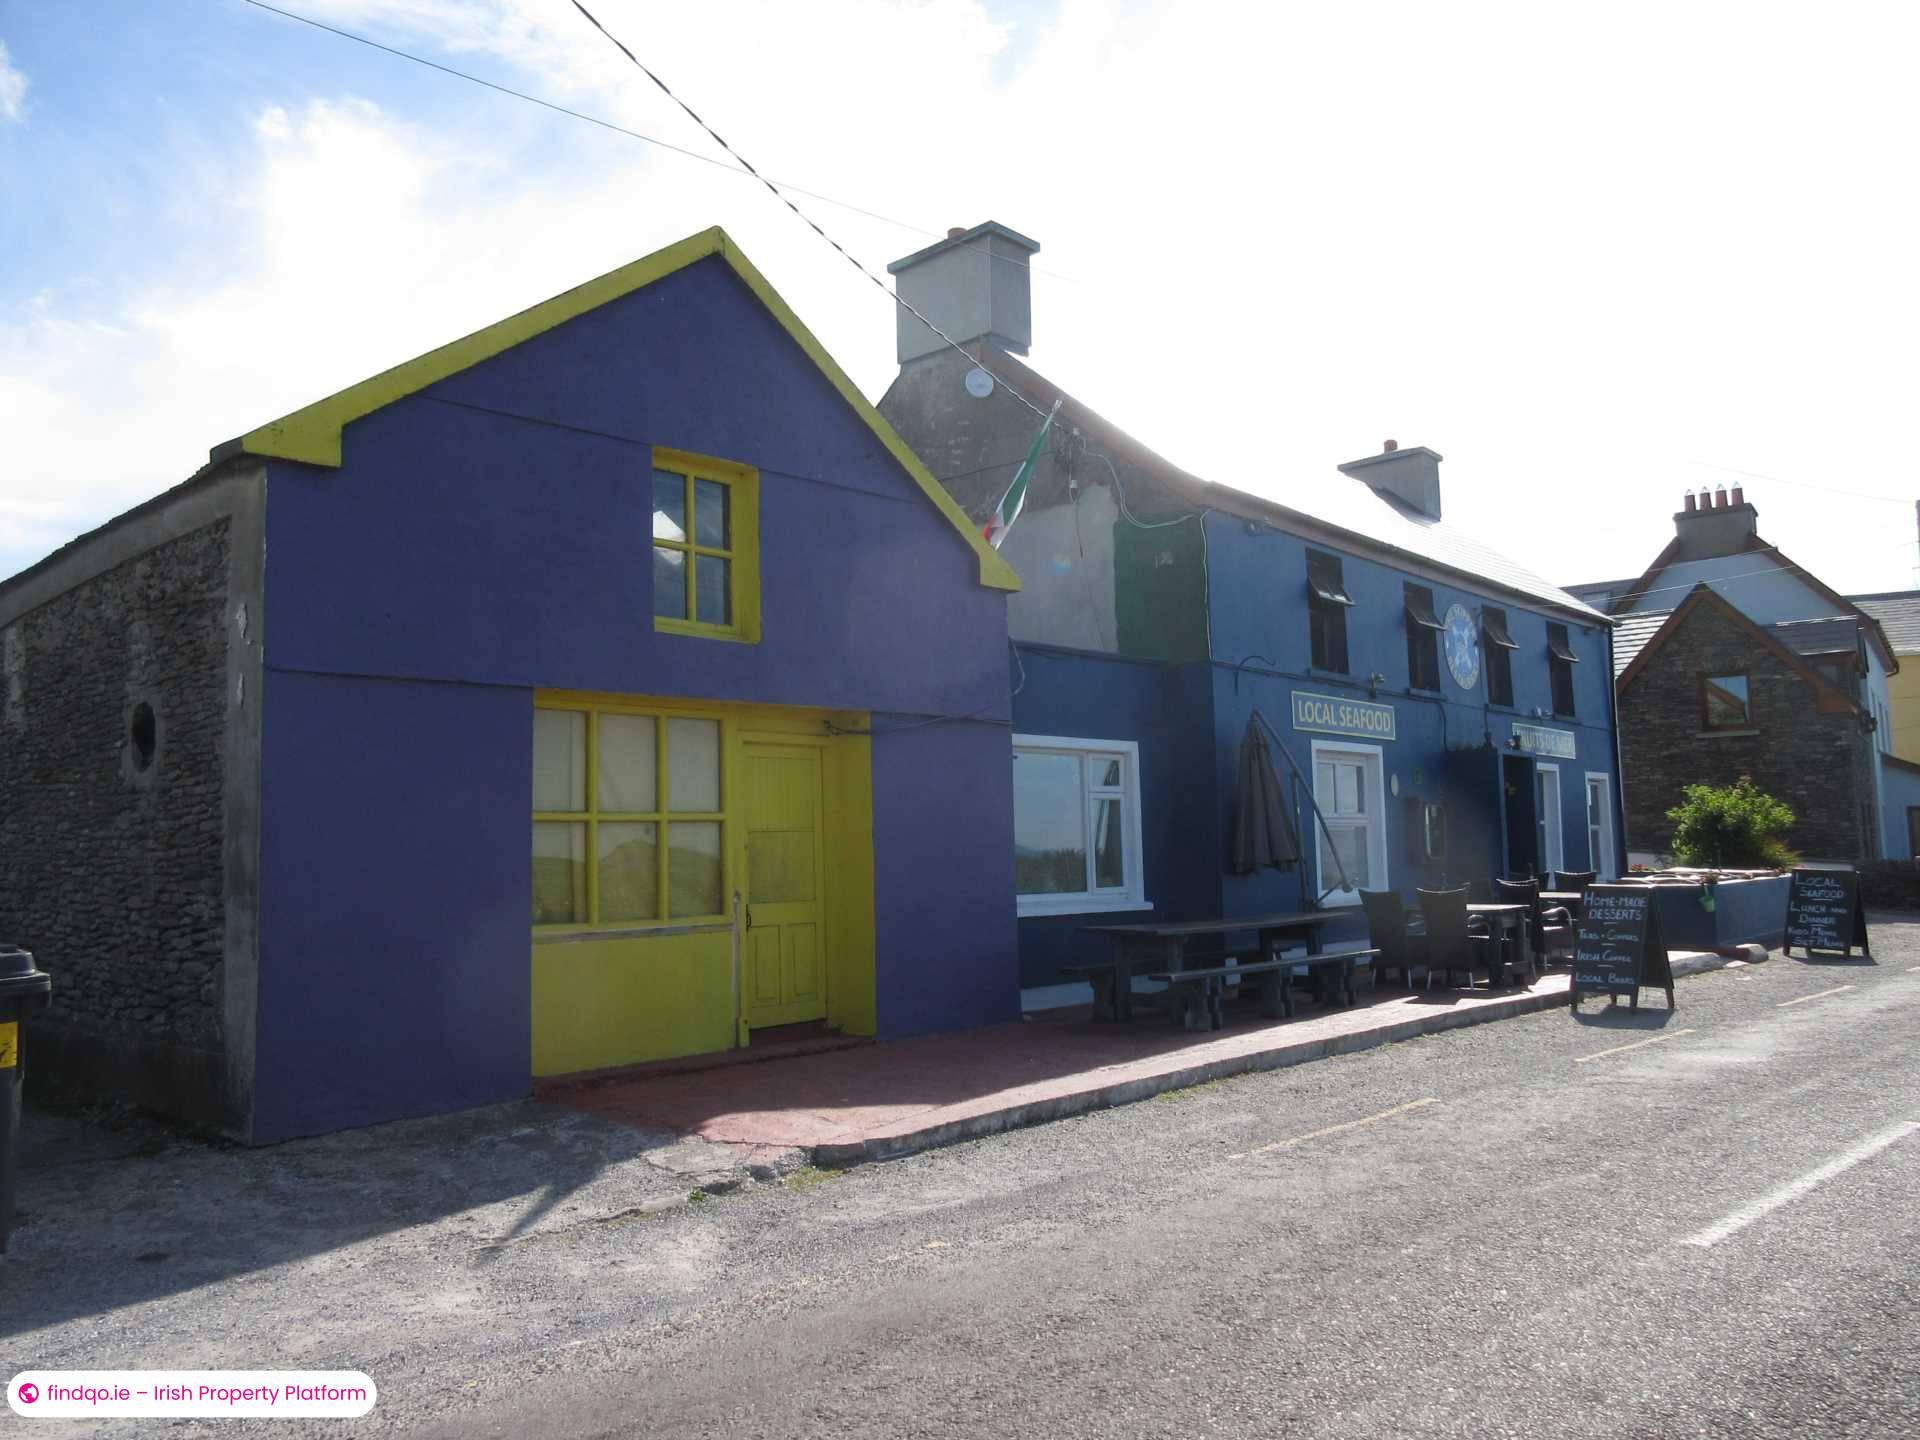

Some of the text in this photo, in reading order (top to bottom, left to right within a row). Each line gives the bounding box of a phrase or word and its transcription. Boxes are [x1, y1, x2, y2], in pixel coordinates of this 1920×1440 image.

[1298, 699, 1391, 732] LOCAL SEAFOOD
[1588, 908, 1642, 920] DESSERTS
